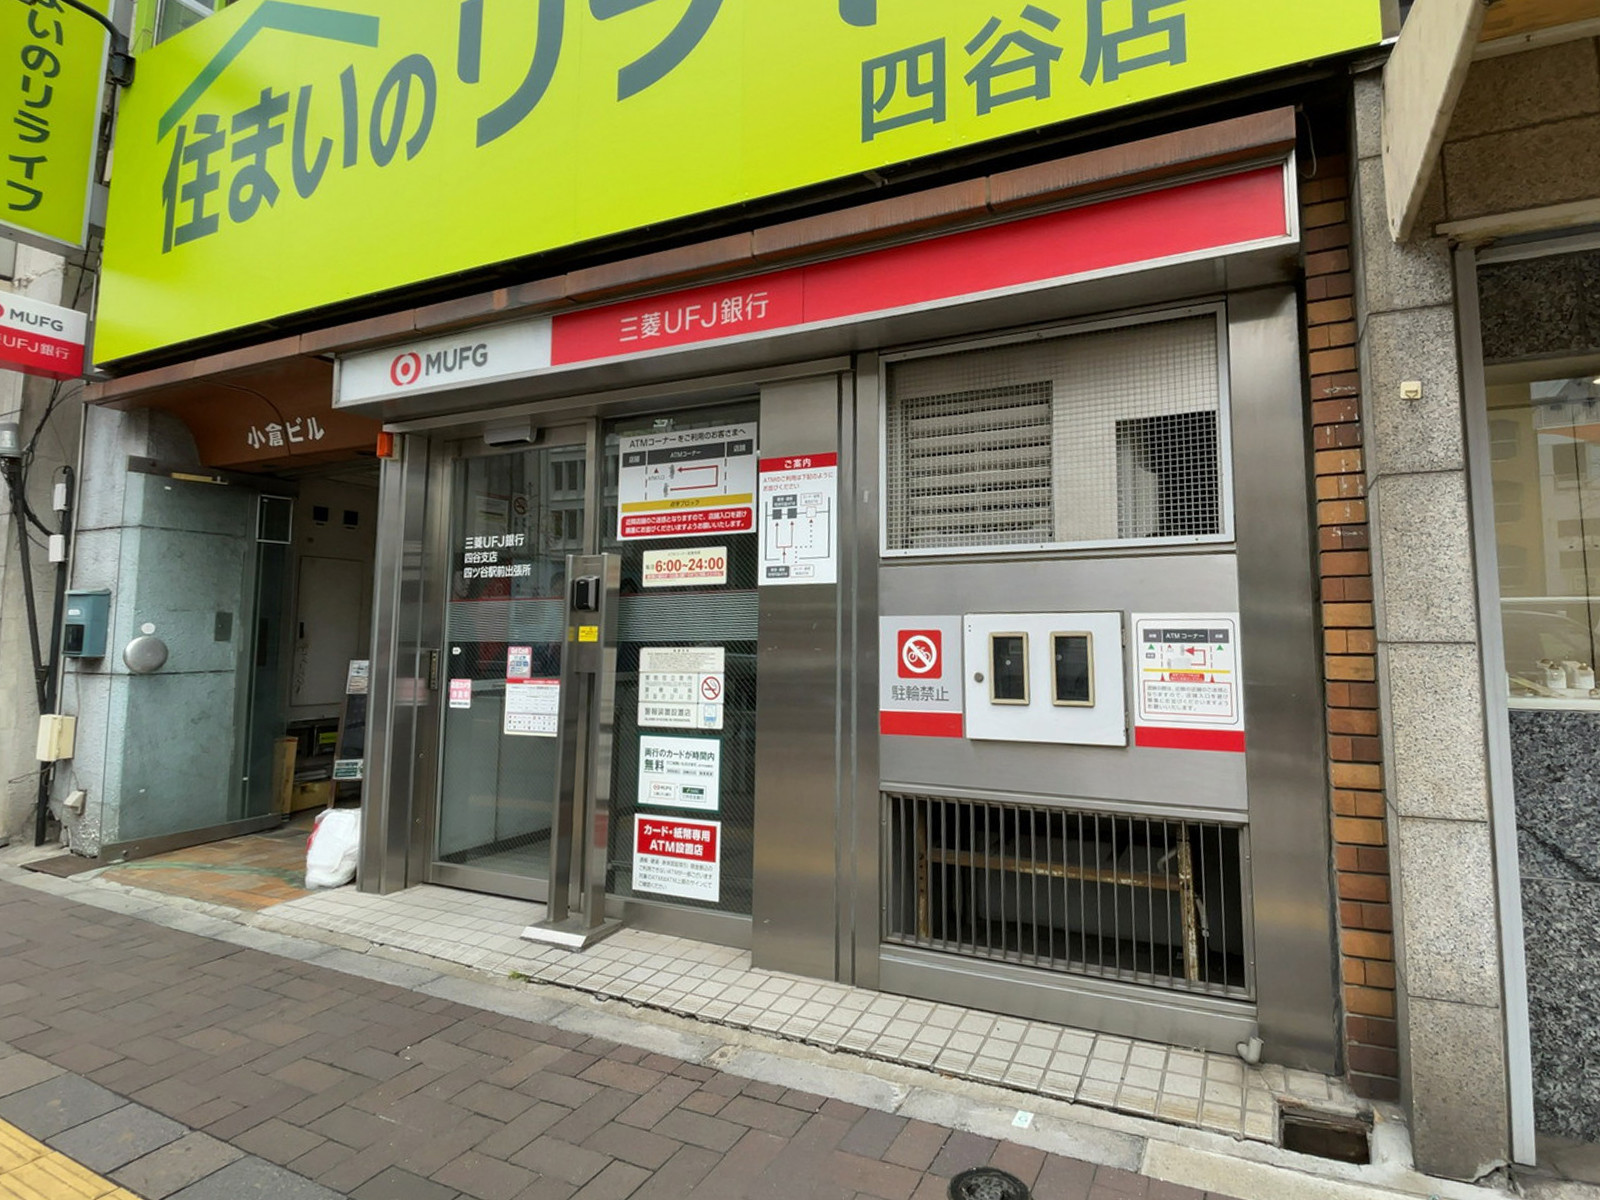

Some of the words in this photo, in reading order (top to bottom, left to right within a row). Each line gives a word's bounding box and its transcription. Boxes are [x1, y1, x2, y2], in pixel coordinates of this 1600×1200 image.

[861, 0, 1187, 143] 四谷店
[10, 308, 64, 332] MUFG
[618, 292, 769, 343] 三菱UFJ銀行
[0, 333, 70, 360] UFJ銀行
[425, 343, 489, 377] MUFG
[247, 416, 325, 449] 小倉ビル
[784, 459, 812, 469] ご案内
[465, 533, 525, 550] 三菱UFJ銀行
[464, 551, 498, 564] 四谷支店
[463, 563, 532, 579] 四ツ谷駅前出張所
[891, 685, 950, 702] 駐輪禁止
[644, 747, 715, 761] 両行のカードが時間内
[644, 759, 664, 772] 無料
[643, 824, 711, 842] カード・紙幣専用
[649, 839, 704, 856] ATM設置店
